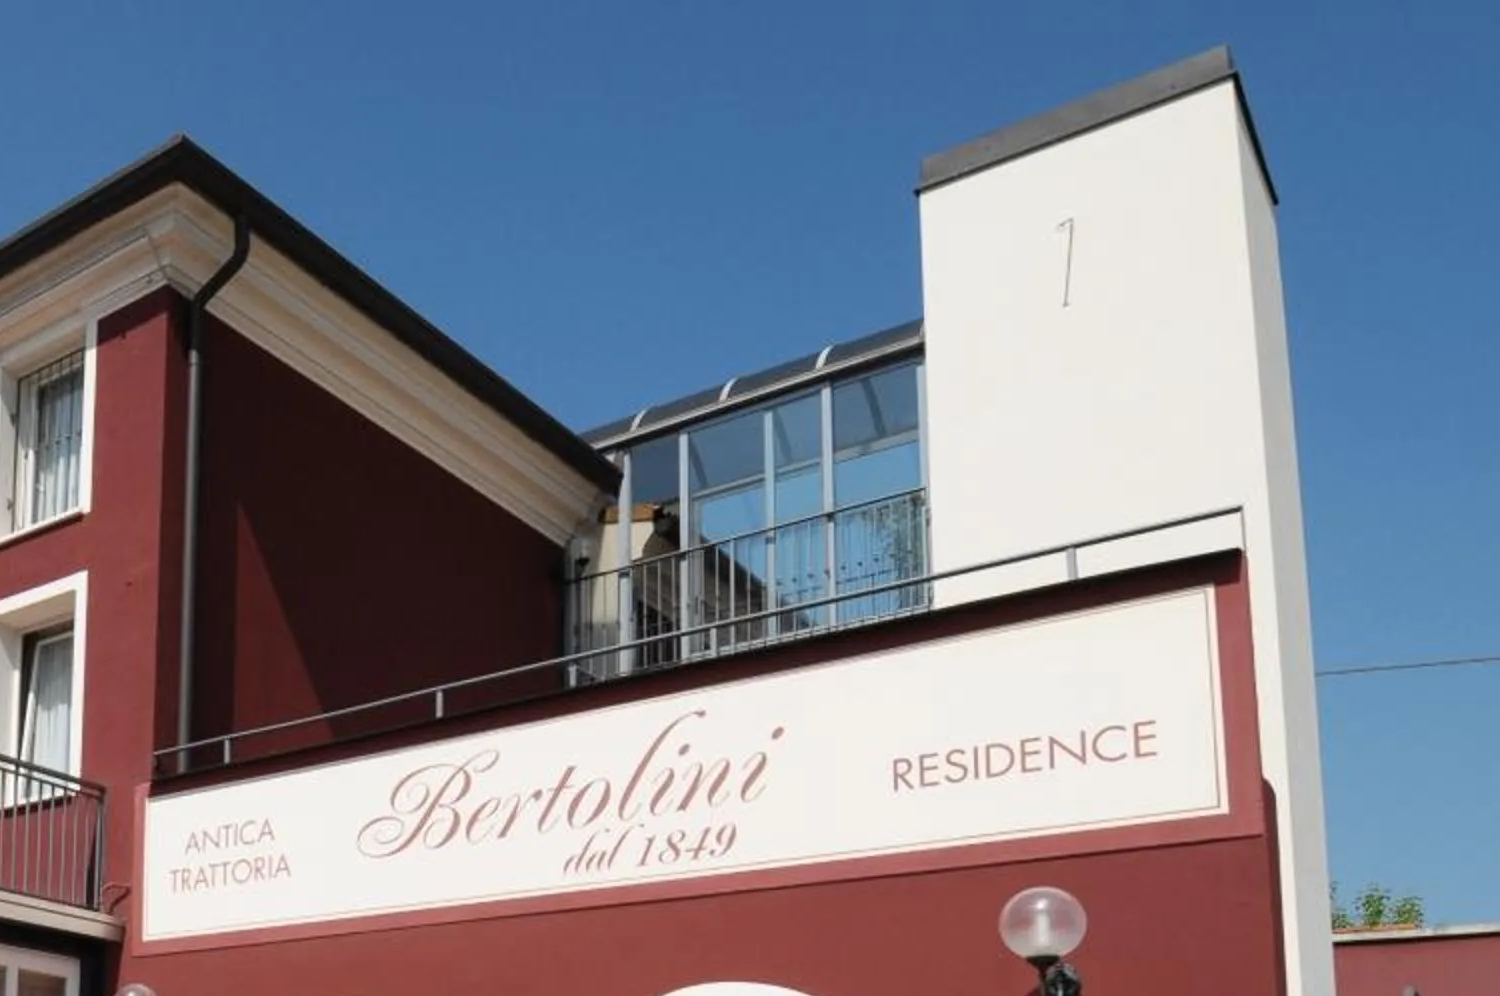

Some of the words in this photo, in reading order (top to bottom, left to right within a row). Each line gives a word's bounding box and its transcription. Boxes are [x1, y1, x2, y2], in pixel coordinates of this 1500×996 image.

[892, 719, 1158, 793] RESIDENCE
[356, 709, 786, 859] Bertolini
[185, 818, 276, 854] ANTICA
[563, 823, 639, 873] dal
[636, 823, 738, 868] 1849
[169, 854, 291, 892] TRATTORIA
